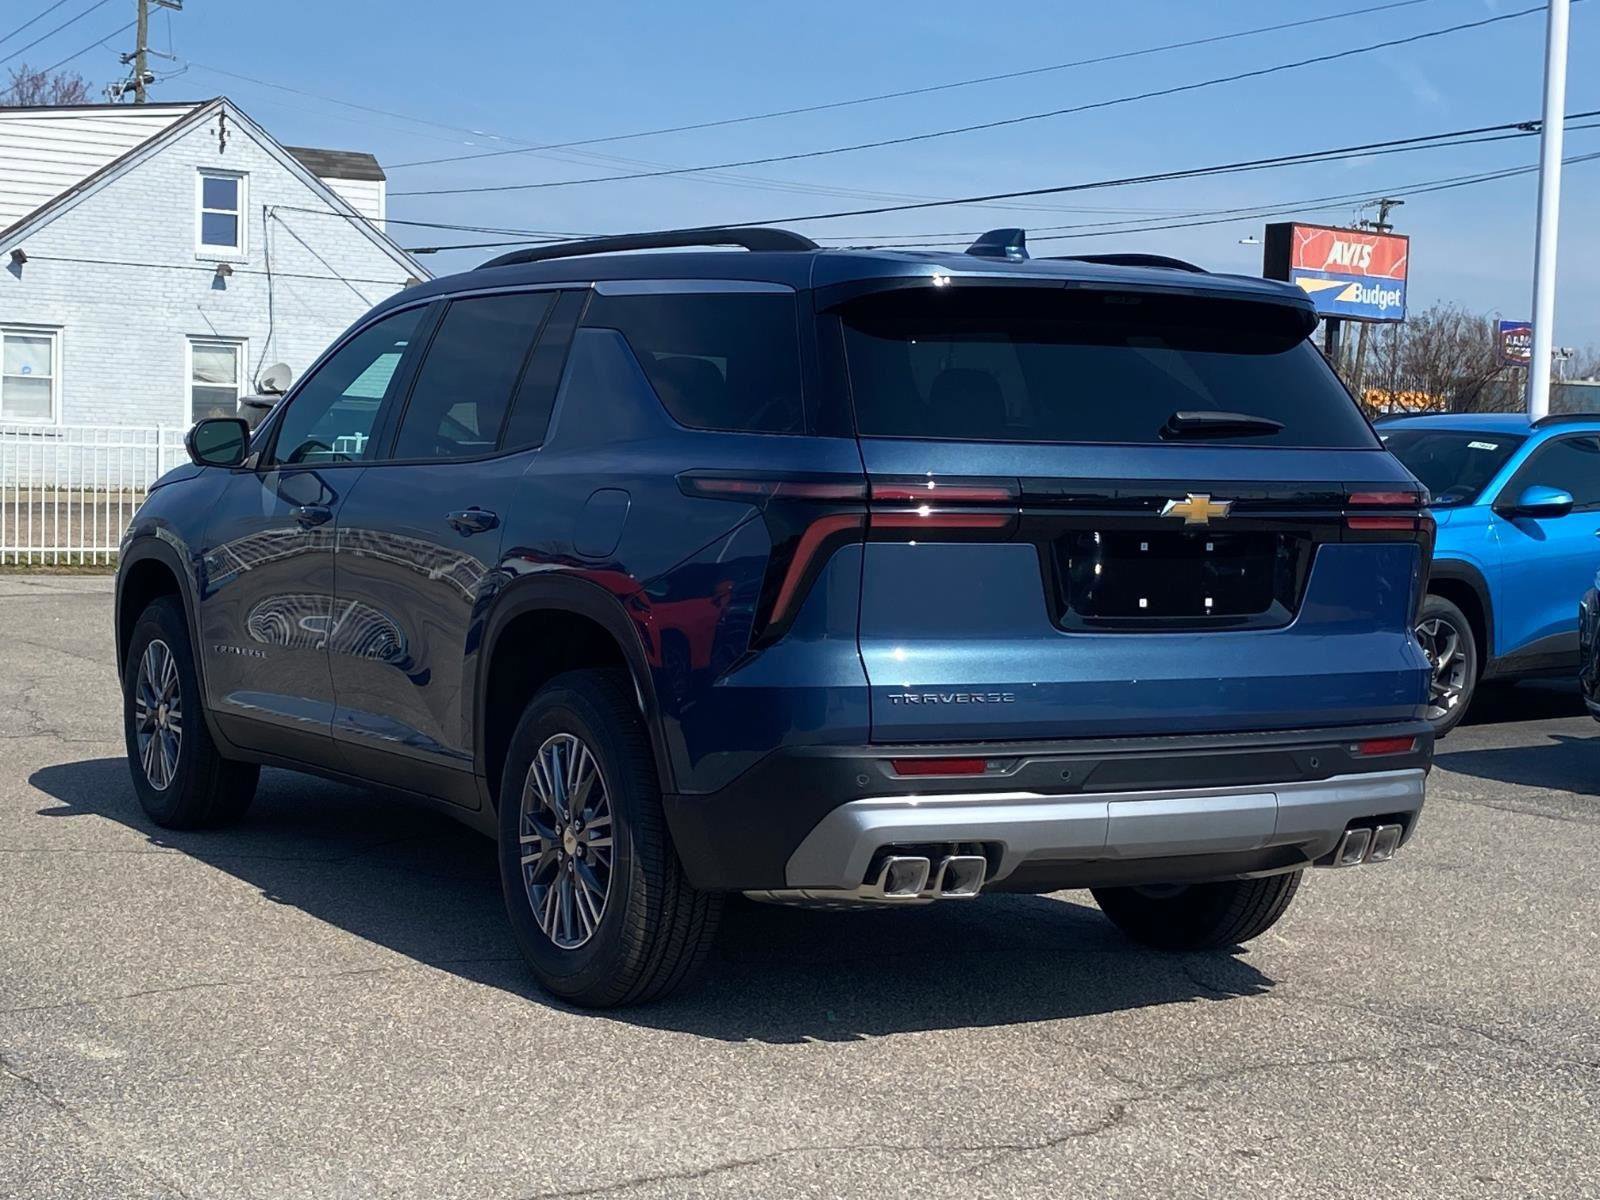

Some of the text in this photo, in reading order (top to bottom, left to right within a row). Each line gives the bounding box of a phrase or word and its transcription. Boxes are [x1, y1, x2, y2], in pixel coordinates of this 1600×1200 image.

[1327, 241, 1372, 268] AVIS
[1353, 283, 1401, 310] Budget
[888, 693, 1016, 704] TRAVERSE
